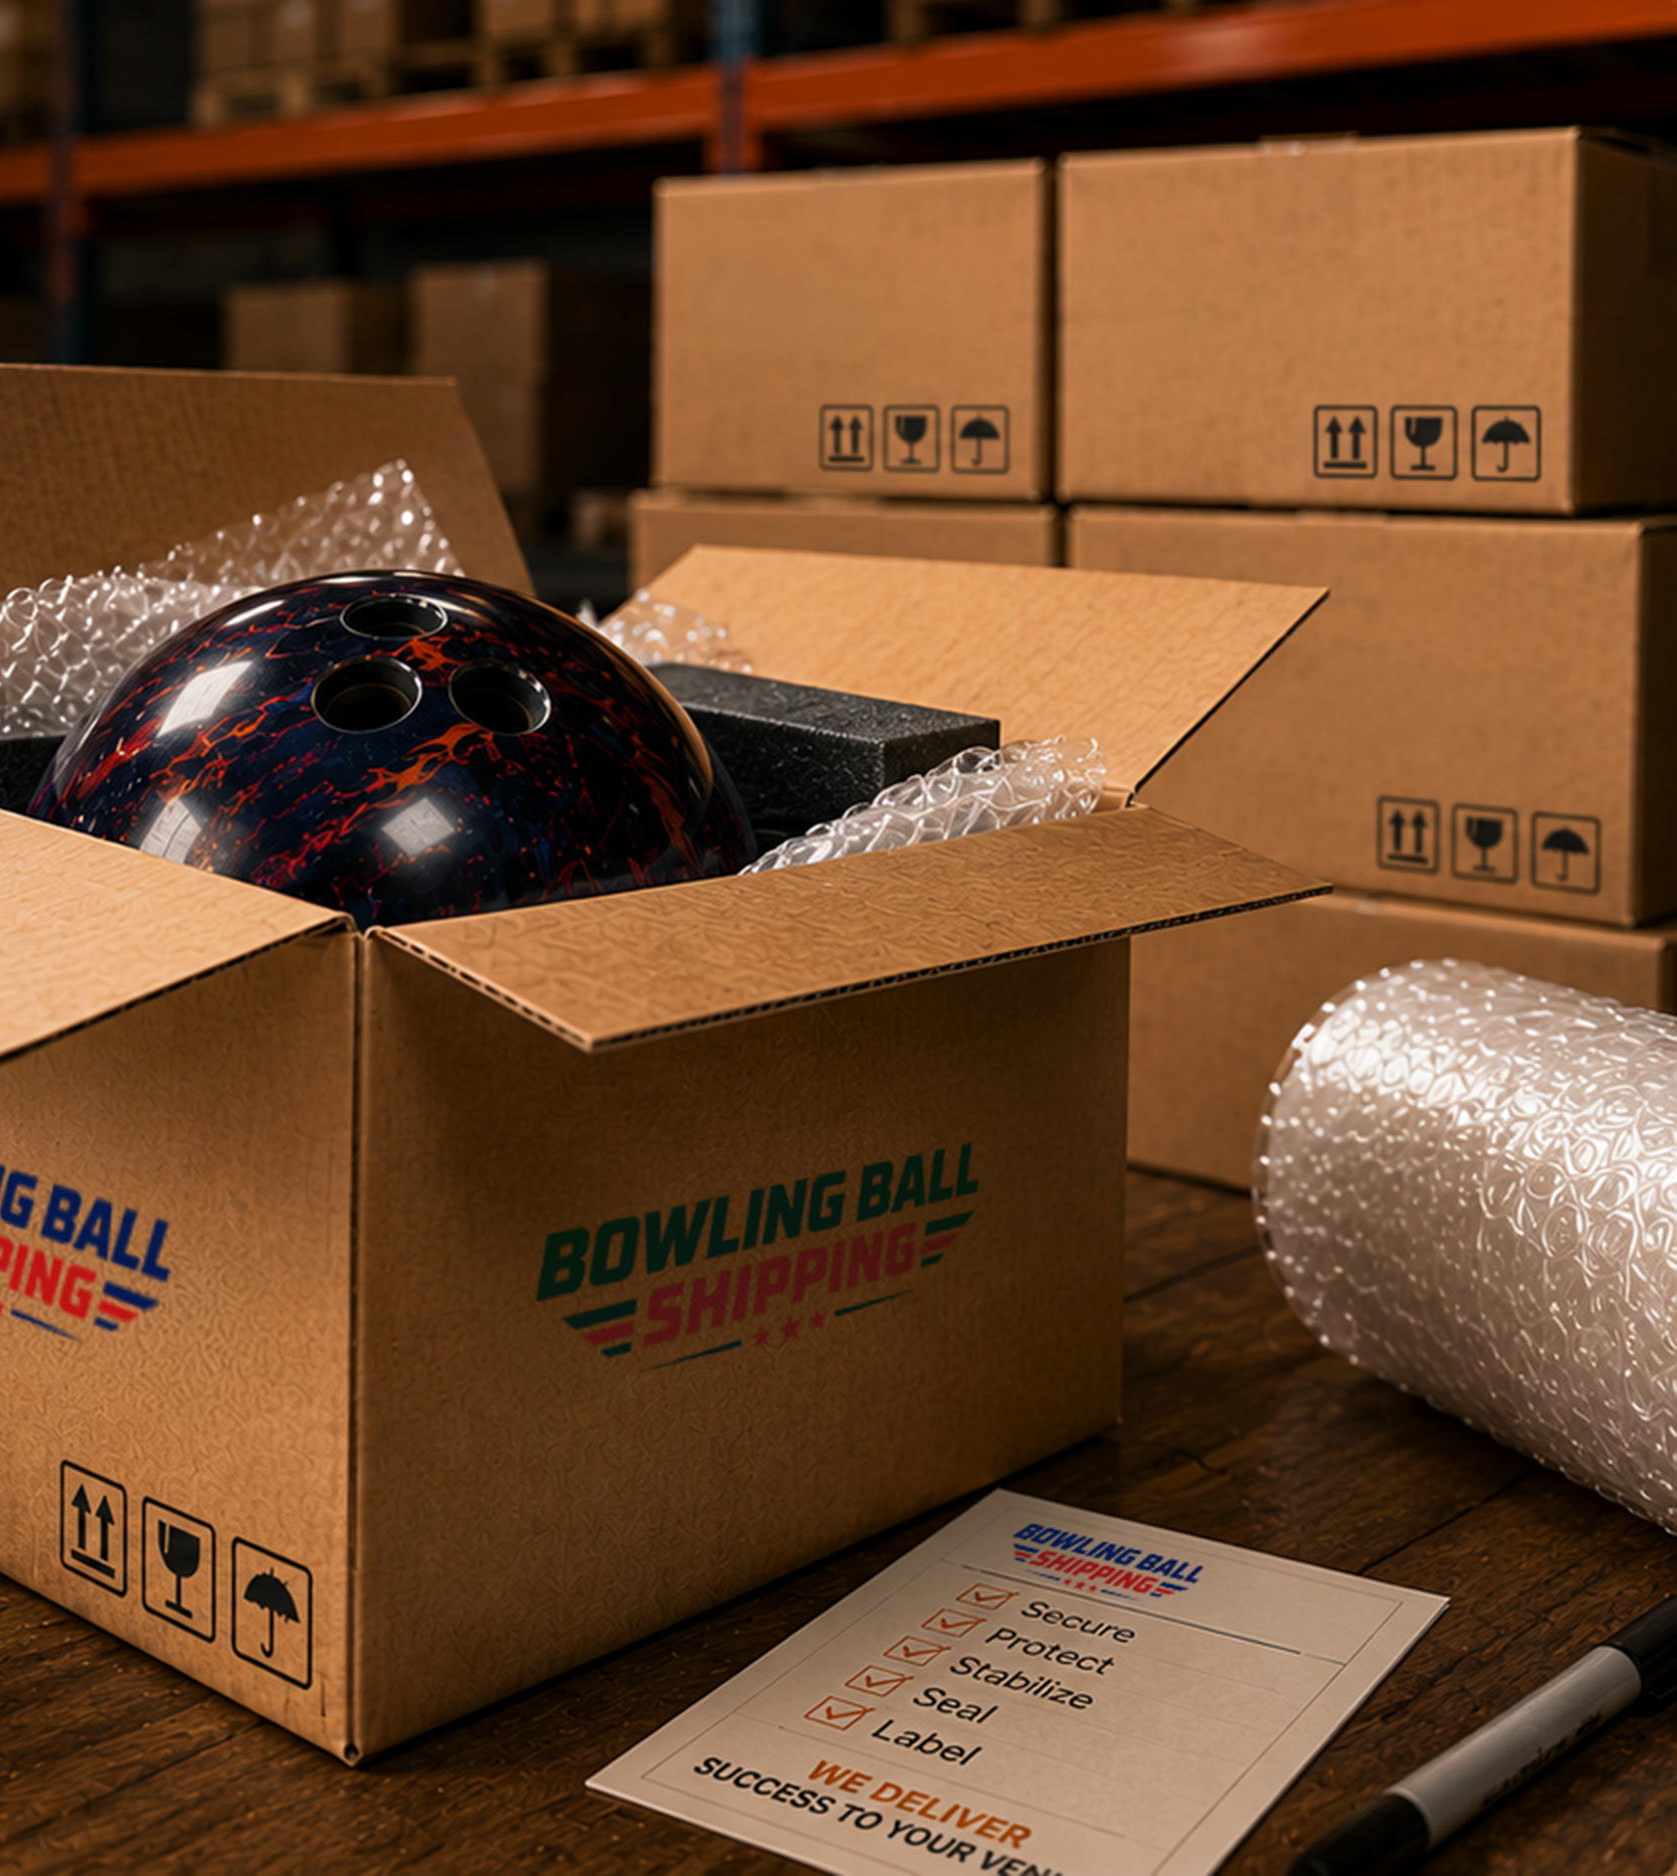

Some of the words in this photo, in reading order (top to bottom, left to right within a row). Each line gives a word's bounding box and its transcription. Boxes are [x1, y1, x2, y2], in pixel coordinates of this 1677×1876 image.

[40, 1183, 171, 1282] BALL
[536, 1170, 846, 1302] BOWLING
[856, 1142, 979, 1222] BALL
[642, 1221, 918, 1347] SHIPPING
[1013, 1523, 1142, 1566] BOWLING
[1135, 1553, 1203, 1584] BALL
[1028, 1550, 1159, 1594] SHIPPING
[1021, 1601, 1135, 1643] Secure
[985, 1627, 1114, 1675] Protect
[912, 1687, 998, 1724] Seal
[949, 1656, 1093, 1709] Stabilize
[871, 1719, 982, 1766] Label
[693, 1757, 837, 1814] SUCCESS
[837, 1803, 883, 1830] TO
[887, 1820, 977, 1863] YOUR
[808, 1759, 873, 1794] WE
[869, 1781, 1032, 1849] DELIVER
